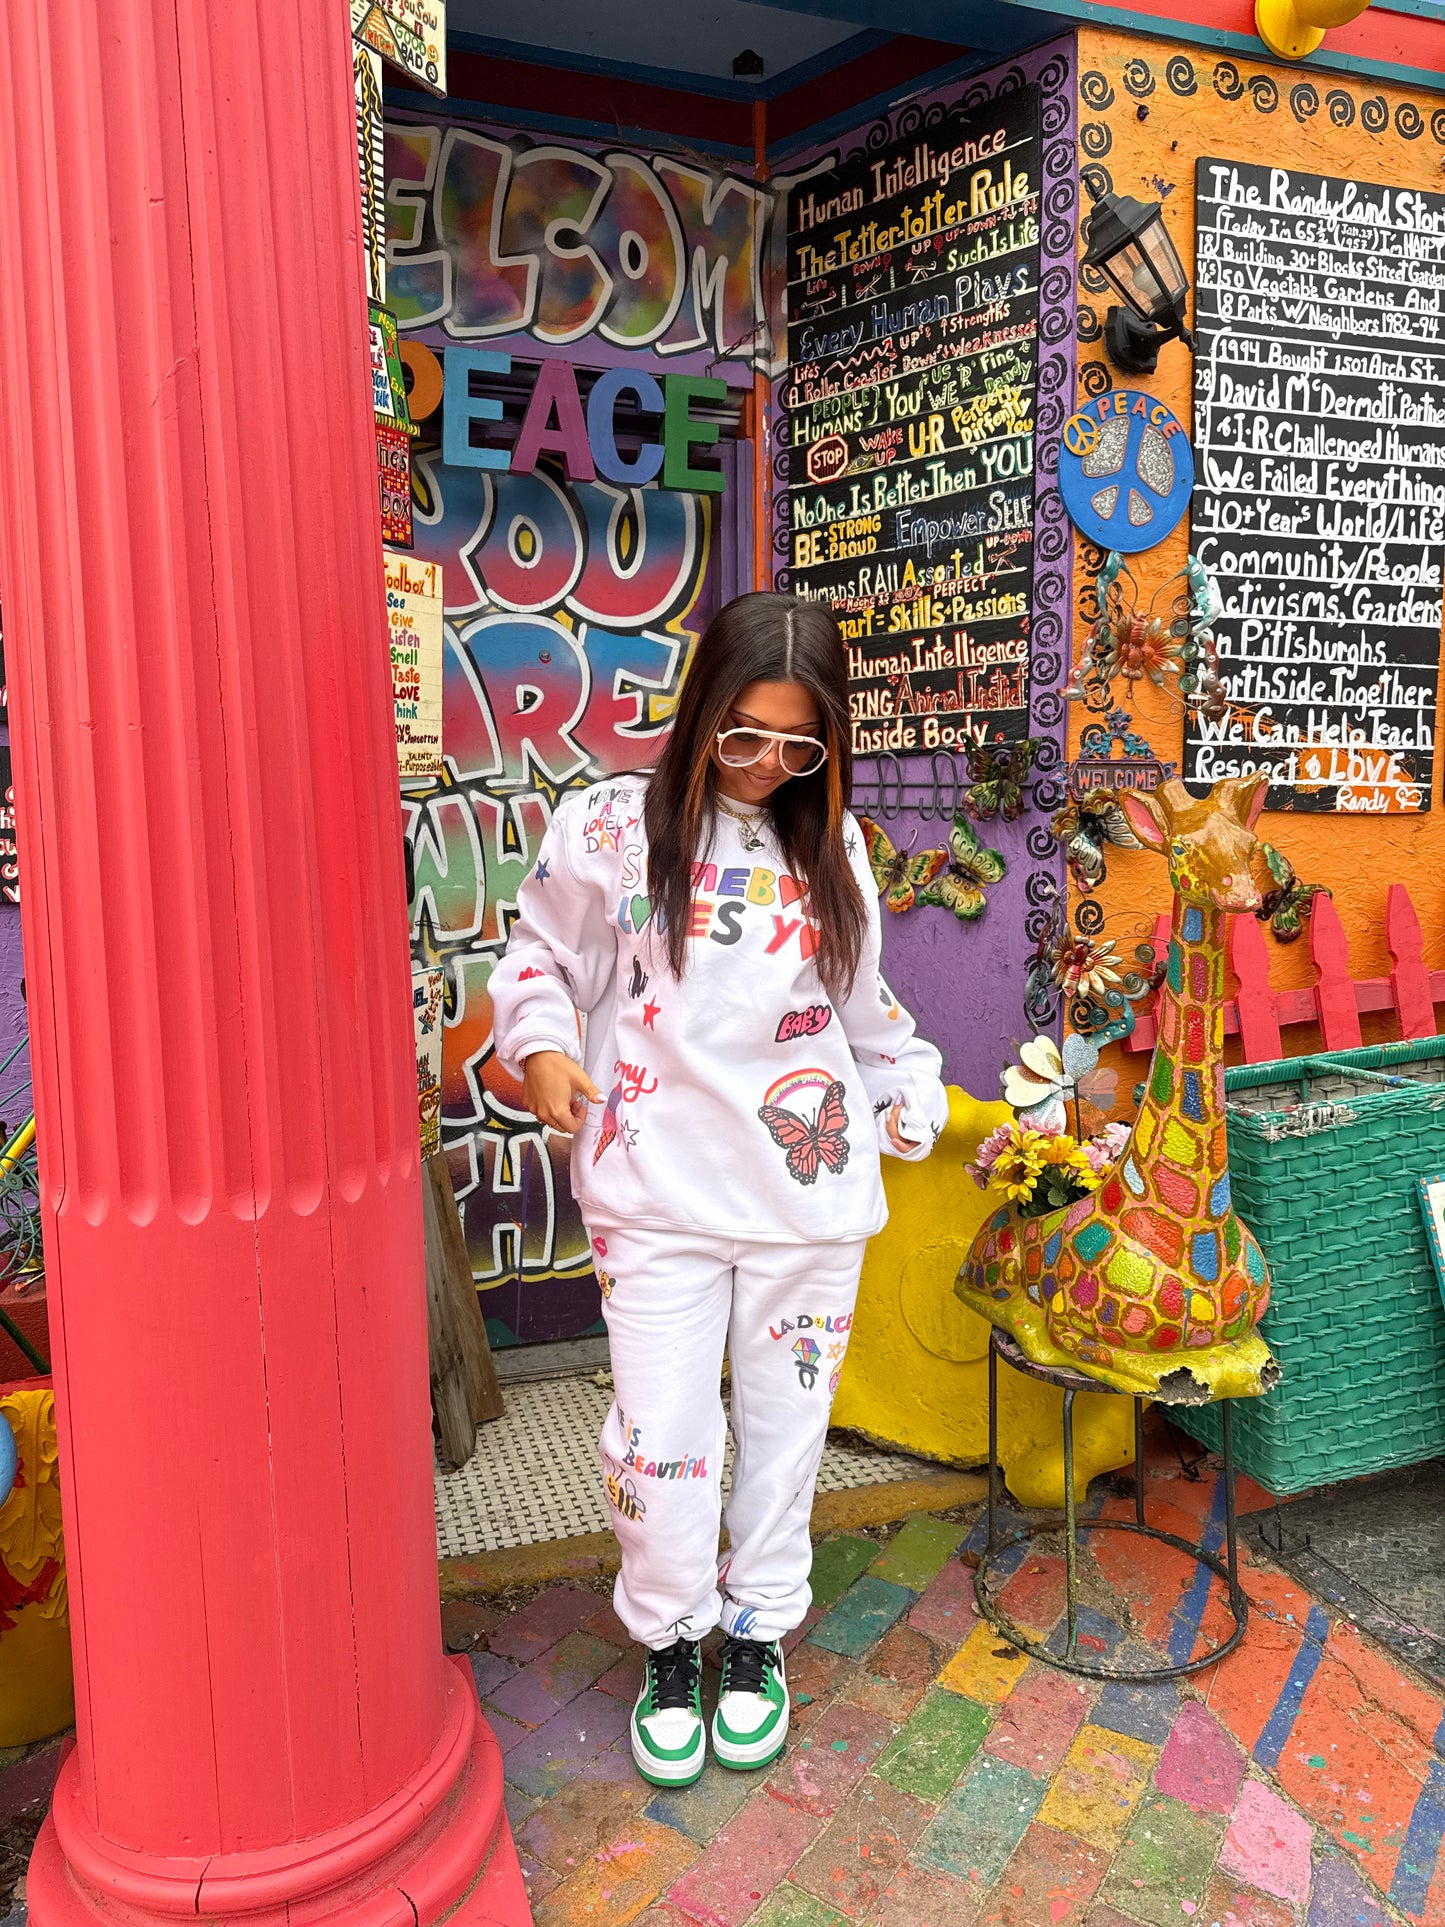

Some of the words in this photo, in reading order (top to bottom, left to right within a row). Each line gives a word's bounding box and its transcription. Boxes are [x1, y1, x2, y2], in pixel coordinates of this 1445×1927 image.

[394, 23, 426, 56] GOOD
[400, 42, 423, 70] BAD
[797, 193, 863, 232] Human
[870, 127, 1006, 203] Intelligence
[1209, 165, 1262, 206] The
[1269, 168, 1392, 234] Randyland
[1395, 191, 1445, 232] Stor
[796, 245, 837, 279] The
[970, 159, 1029, 213] Rule
[1222, 210, 1266, 242] Today
[1269, 218, 1292, 239] I'm
[911, 238, 931, 255] UP
[946, 235, 988, 272] Such
[1010, 215, 1040, 247] Life
[1379, 229, 1403, 254] I'm
[1403, 232, 1445, 261] HAPPY
[852, 256, 881, 277] DOWN
[1199, 233, 1214, 255] 18
[1223, 238, 1285, 275] Building
[1318, 251, 1365, 275] Blocks
[1366, 256, 1409, 282] Street
[1407, 261, 1445, 287] Garden
[806, 278, 828, 296] Life
[1221, 268, 1245, 289] 50
[1324, 278, 1395, 308] Gardens
[1404, 288, 1440, 313] And
[377, 311, 397, 341] Nose
[801, 321, 863, 362] Every
[871, 294, 949, 338] Human
[955, 264, 1031, 311] Plays
[949, 302, 1011, 333] Strengths
[1222, 292, 1234, 318] 8
[1237, 294, 1277, 322] Parks
[1382, 312, 1440, 339] 1982-94
[931, 363, 951, 385] US
[979, 347, 1016, 375] Fine
[984, 355, 1033, 396] Dandy
[1218, 338, 1261, 363] 1994
[1268, 341, 1328, 377] Bought
[1368, 353, 1407, 380] Arch
[1409, 358, 1440, 382] St.
[390, 376, 406, 399] Ears
[788, 388, 799, 408] A
[803, 373, 840, 401] Roller
[812, 386, 871, 421] PEOPLE
[927, 381, 959, 411] WE
[1195, 368, 1212, 391] 28
[1219, 373, 1281, 411] David
[1400, 390, 1445, 425] Partne
[1097, 392, 1181, 439] PEACE
[859, 426, 904, 452] WAKE
[1273, 421, 1382, 473] Challenged
[813, 446, 844, 470] STOP
[874, 448, 897, 466] UP
[850, 484, 871, 516] Is
[872, 470, 929, 509] Better
[925, 459, 976, 498] Then
[980, 438, 1034, 484] YOU
[1207, 455, 1255, 491] We
[1260, 457, 1319, 495] Failed
[1325, 462, 1445, 518] Everything
[795, 531, 825, 567] BE
[829, 515, 882, 543] STRONG
[829, 536, 877, 559] PROUD
[896, 508, 986, 558] Empower
[795, 578, 856, 603] Humans
[901, 543, 984, 590] Assorted
[387, 591, 406, 609] See
[837, 606, 875, 640] mart
[952, 588, 1028, 623] Passions
[1352, 587, 1444, 624] Gardens
[391, 611, 414, 629] Give
[389, 627, 420, 649] Listen
[1240, 620, 1387, 680] Pittsburghs
[390, 646, 418, 665] Smell
[848, 647, 911, 680] Human
[911, 630, 1030, 674] Intelligence
[392, 664, 420, 684] Taste
[393, 682, 420, 702] LOVE
[849, 687, 896, 719] SING
[1329, 666, 1433, 721] Together
[851, 714, 916, 753] Inside
[922, 712, 990, 753] Body
[1196, 705, 1244, 743] We
[1252, 706, 1300, 745] Can
[1308, 708, 1367, 759] Help
[1368, 709, 1433, 748] Teach
[1077, 768, 1158, 791] WELCOME
[1195, 745, 1297, 782] Respect
[1329, 748, 1405, 783] LOVE
[588, 788, 634, 811] HAVE
[600, 801, 612, 816] A
[1336, 785, 1390, 813] Randy
[583, 814, 639, 837] LOVELY
[585, 829, 623, 853] DAY
[775, 1003, 832, 1043] BABY
[768, 1318, 796, 1341] LA
